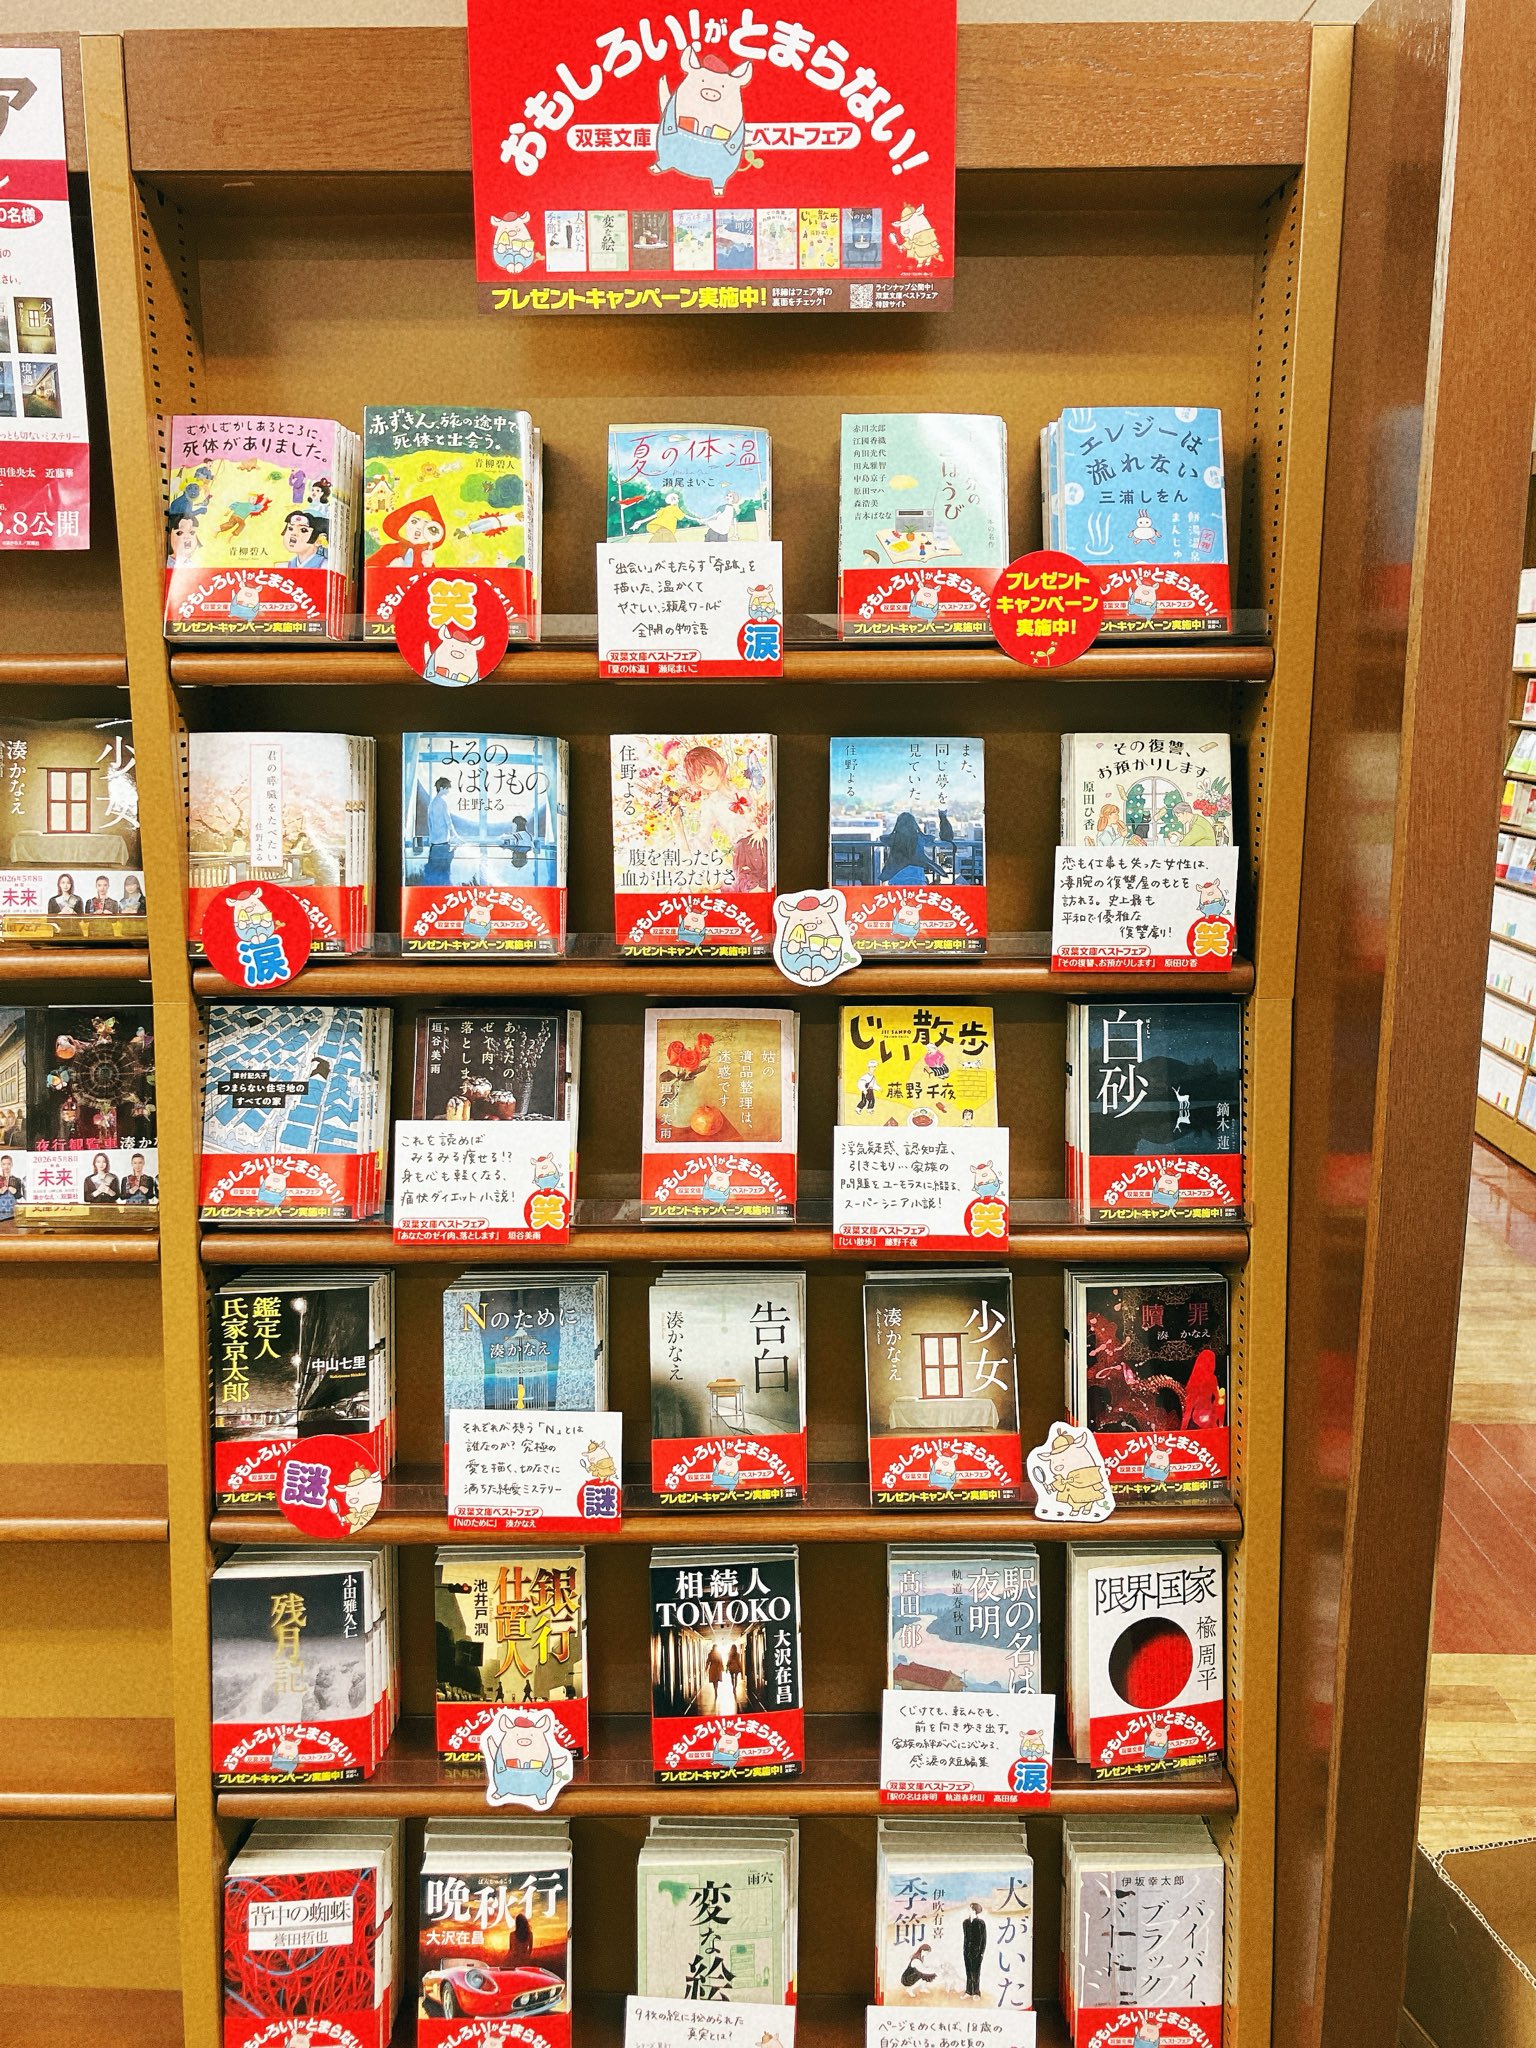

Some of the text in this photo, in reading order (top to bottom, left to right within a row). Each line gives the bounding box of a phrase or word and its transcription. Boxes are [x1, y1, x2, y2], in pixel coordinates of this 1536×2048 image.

[574, 125, 854, 148] 双葉文庫 ベストフェア
[601, 213, 615, 252] 変な絵
[492, 288, 766, 310] プレゼントキャンペーン実施中!
[772, 288, 833, 296] 詳細はフェア帯の
[875, 283, 934, 291] ラインナップ公開中!
[875, 291, 938, 300] 双葉文庫ベストフェア
[40, 302, 53, 327] 少女
[772, 298, 826, 307] 裏面をチェック!
[875, 300, 906, 308] 特設サイト
[186, 419, 323, 443] むかしむかしあるところに、
[369, 410, 520, 436] 赤ずきん、旅の途中で
[392, 433, 501, 451] 死体と出会う。
[1079, 416, 1203, 456] エレジーは
[183, 437, 327, 462] 死体がありました。
[621, 434, 760, 482] 夏の体温
[474, 458, 515, 469] 青柳碧人
[854, 462, 886, 470] 田丸雅智
[1086, 454, 1200, 486] 流れない
[663, 478, 715, 487] 瀬尾まいこ
[1099, 491, 1188, 504] 三浦しをん
[228, 546, 269, 557] 青柳碧人
[614, 582, 703, 593] 描いた、温かくて
[1006, 573, 1089, 590] プレゼント
[429, 580, 477, 630] 笑
[618, 601, 721, 614] やさしい、瀬尾ワールド
[997, 596, 1099, 612] キャンペーン
[172, 622, 306, 633] プレゼントキャンペーン実施中!
[632, 622, 708, 638] 全開の物語
[1016, 620, 1076, 637] 実施中!
[746, 625, 778, 660] 涙
[610, 651, 697, 661] 双葉文庫ベストフェア
[658, 665, 698, 673] 瀬尾まいこ
[442, 740, 508, 765] よるの
[1114, 739, 1190, 756] その復讐、
[844, 745, 857, 797] 住野よる
[909, 744, 921, 800] 見ていた
[936, 744, 949, 804] 同じ夢を
[961, 744, 977, 779] また、
[1097, 759, 1209, 779] お預かりします
[8, 740, 27, 815] 湊かなえ
[457, 769, 549, 794] ばけもの
[620, 745, 637, 815] 住野よる
[266, 750, 278, 863] 君の膵臓をたべたい
[457, 798, 504, 811] 住野よる
[1083, 781, 1094, 830] 原田ひ香
[255, 823, 263, 861] 住野よる
[629, 848, 723, 867] 腹を割ったら
[1062, 857, 1208, 870] 恋も仕事も失った女性は、
[621, 869, 736, 887] 血が出るだけさ
[2, 888, 37, 906] 未来
[1062, 911, 1141, 924] 平和で優雅な
[1194, 921, 1228, 955] 笑
[239, 937, 289, 985] 涙
[1062, 947, 1147, 956] 双葉文庫ベストフェア
[1164, 958, 1198, 967] 原田ひ香
[431, 1023, 442, 1073] 垣谷美雨
[850, 1009, 988, 1062] じい散歩
[460, 1022, 473, 1094] 落とします
[503, 1022, 515, 1078] あなたの
[761, 1051, 776, 1077] 姑の
[1097, 1009, 1149, 1119] 白砂
[221, 1083, 304, 1093] つまらない住宅地の
[718, 1051, 731, 1107] 迷惑です
[740, 1051, 753, 1128] 遺品整理は、
[887, 1082, 956, 1099] 藤野千夜
[236, 1097, 282, 1106] すべての家
[660, 1084, 672, 1138] 垣谷美雨
[402, 1133, 485, 1147] これを読めば
[38, 1168, 73, 1186] 未来
[401, 1191, 515, 1206] 痛快ダイエット小説!
[845, 1198, 942, 1209] スーパーシニア小説!
[402, 1220, 485, 1229] 双葉文庫ベストフェア
[532, 1197, 565, 1228] 笑
[971, 1204, 1004, 1237] 笑
[508, 1232, 541, 1240] 垣谷美雨
[843, 1227, 925, 1235] 双葉文庫ベストフェア
[885, 1237, 918, 1246] 藤野千夜
[253, 1297, 281, 1359] 鑑定人
[462, 1303, 578, 1331] Nのために
[221, 1298, 249, 1403] 氏家京太郎
[490, 1343, 551, 1358] 湊かなえ
[667, 1311, 683, 1381] 湊かなえ
[749, 1301, 790, 1394] 告白
[884, 1308, 902, 1381] 湊かなえ
[964, 1300, 1009, 1392] 少女
[312, 1356, 366, 1372] 中山七里
[284, 1463, 328, 1506] 謎
[878, 1491, 1000, 1502] プレゼントキャンペーン実施中!
[457, 1508, 539, 1516] 双葉文庫ベストフェア
[586, 1487, 616, 1516] 謎
[506, 1519, 536, 1528] 湊かなえ
[676, 1568, 770, 1600] 相続人
[1095, 1566, 1217, 1615] 限界国家
[342, 1575, 357, 1638] 小田雅久仁
[474, 1579, 488, 1636] 池井戸潤
[530, 1566, 581, 1664] 銀行
[656, 1597, 790, 1628] TOMOKO
[967, 1567, 1001, 1639] 夜明
[495, 1566, 533, 1678] 仕置人
[1003, 1566, 1036, 1694] 駅の名は
[270, 1592, 307, 1694] 残月記
[1196, 1616, 1217, 1690] 楡周平
[774, 1630, 792, 1704] 大沢在昌
[915, 1721, 1009, 1734] 前を向き歩き出す。
[909, 1755, 989, 1768] 感涙の短編集
[1015, 1764, 1046, 1791] 涙
[747, 1872, 773, 1885] 雨穴
[1122, 1876, 1184, 1886] 伊坂幸太郎
[251, 1900, 351, 1926] 背中の蜘蛛
[427, 1873, 563, 1930] 晩秋行
[894, 1877, 927, 1947] 季節
[933, 1889, 945, 1938] 伊吹有喜
[274, 1931, 328, 1947] 誉田哲也
[426, 1931, 484, 1945] 大沢在昌
[684, 1881, 735, 2001] 変な絵
[997, 1877, 1028, 2007] 犬がいた
[1101, 1901, 1127, 1976] バード
[1142, 1900, 1169, 1996] ブラック
[1178, 1900, 1206, 2006] バイバイ、
[687, 2027, 732, 2040] 真実とは?
